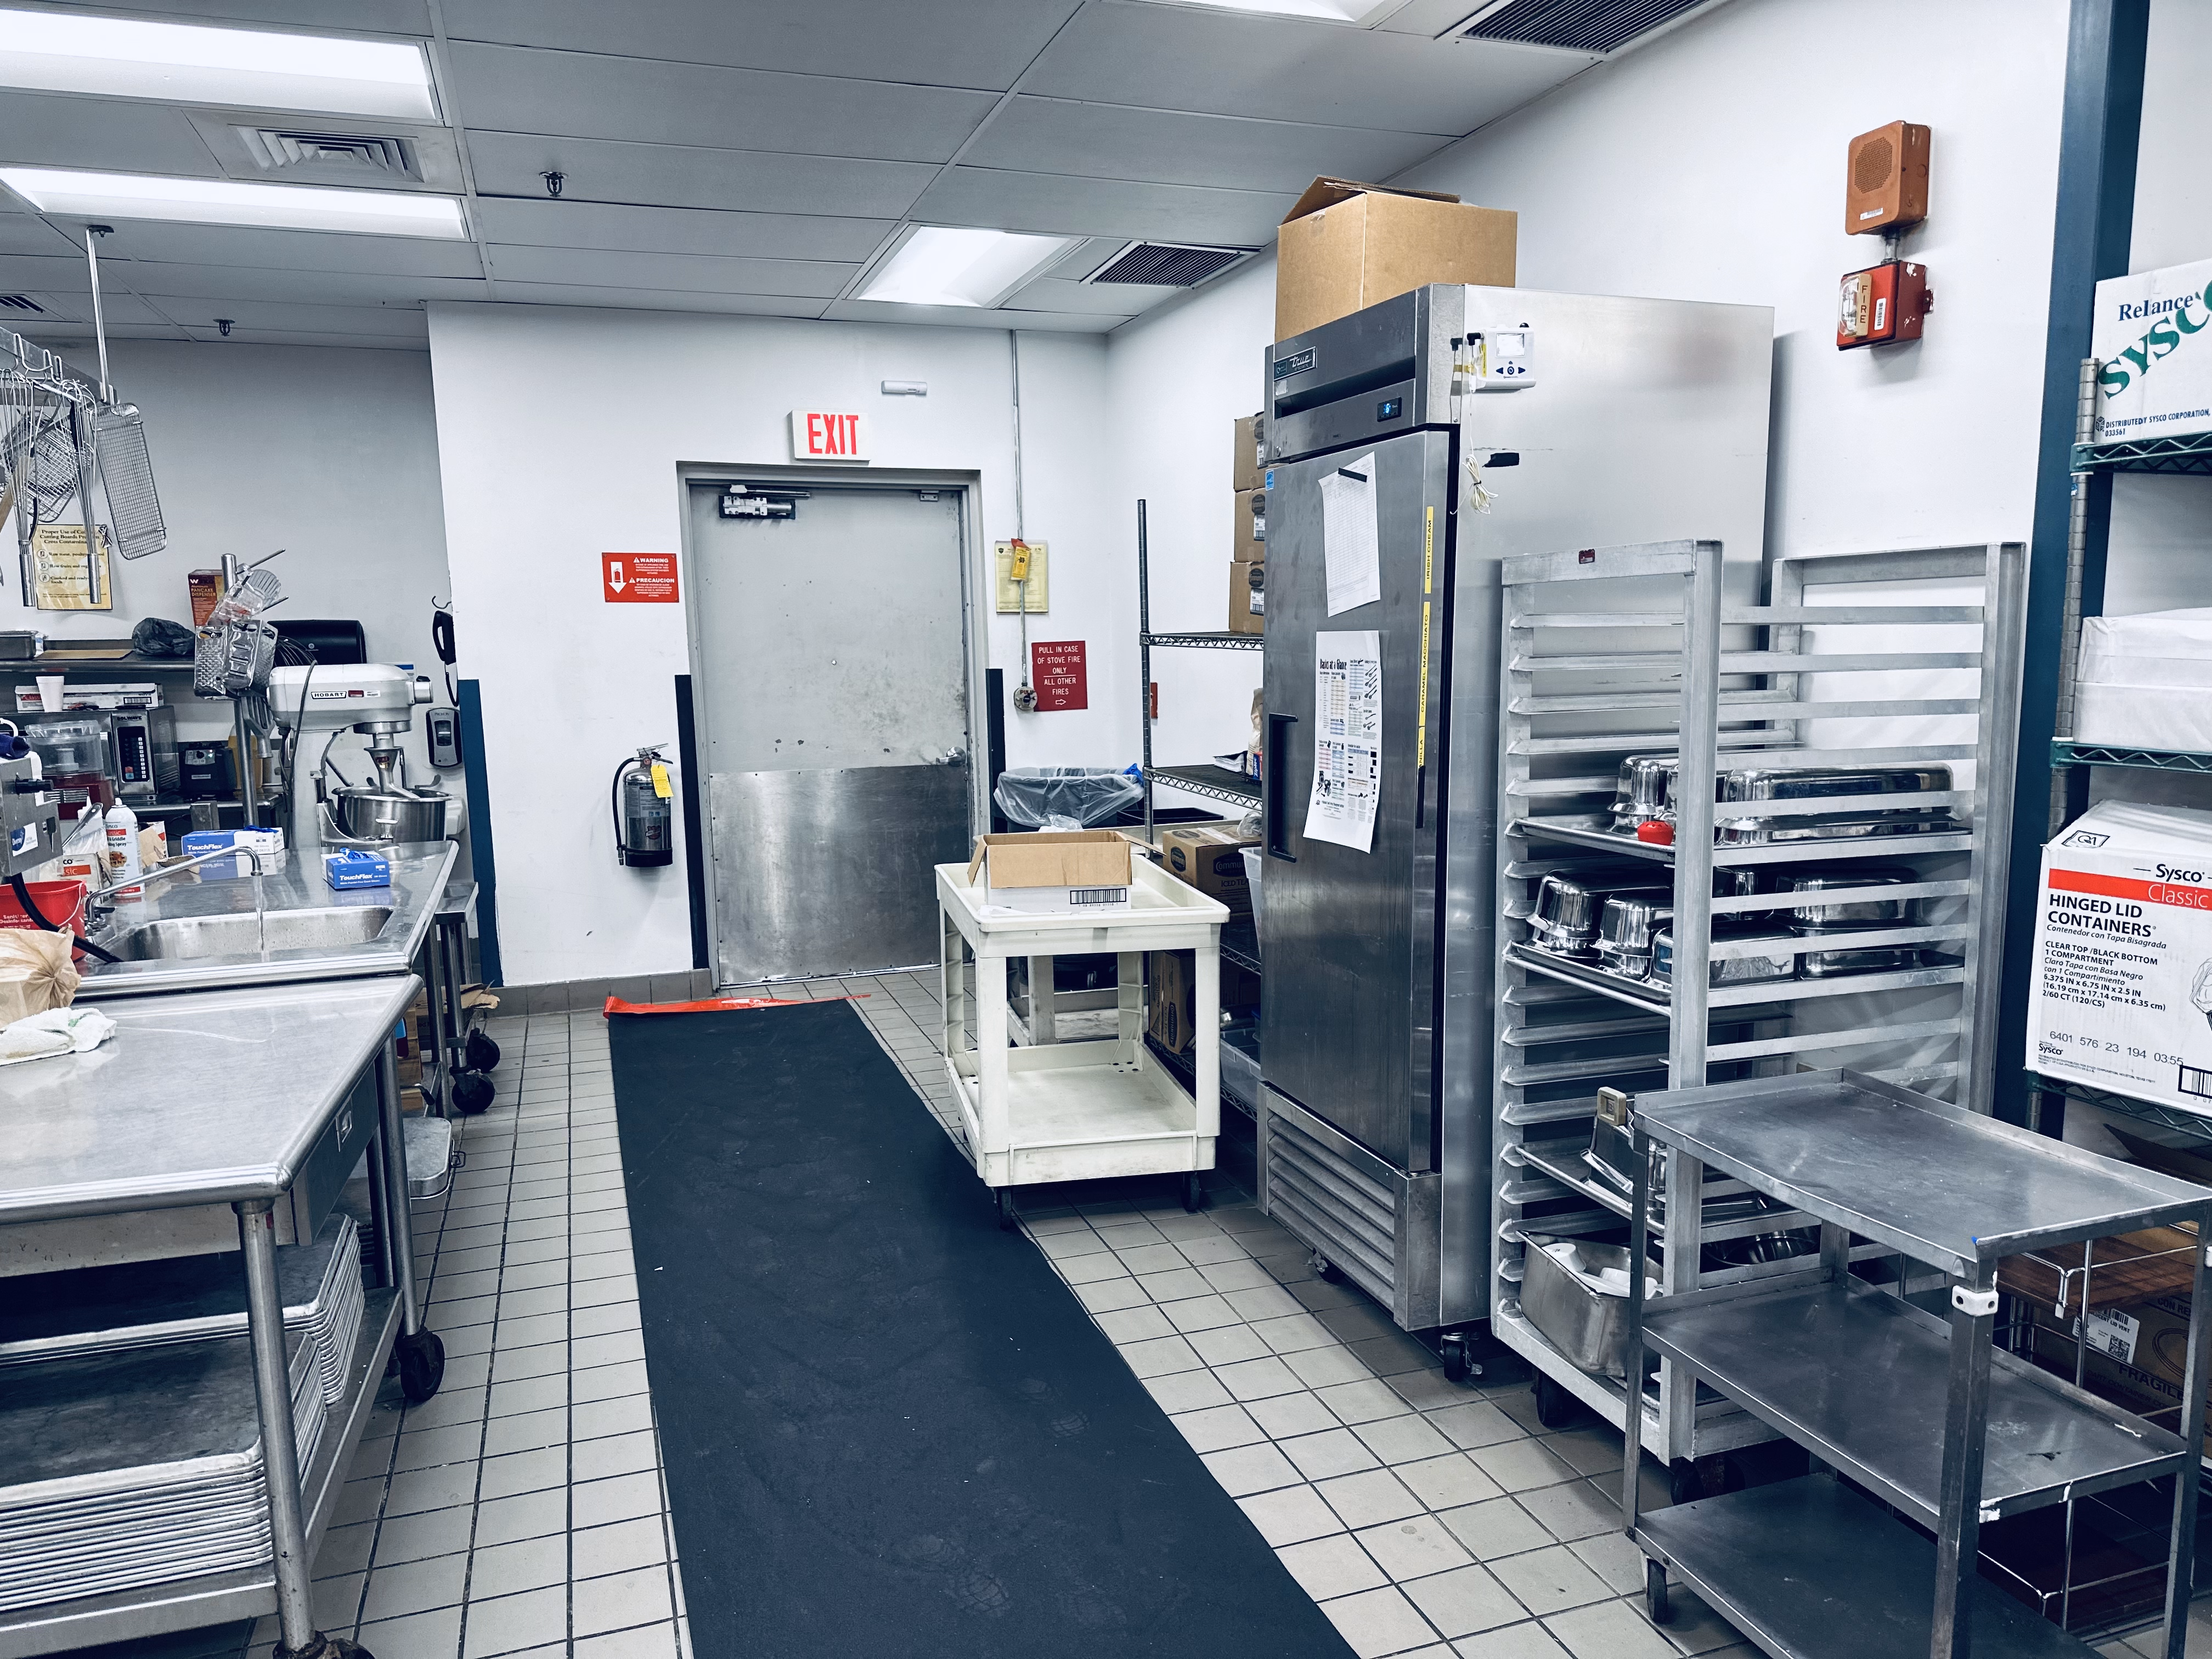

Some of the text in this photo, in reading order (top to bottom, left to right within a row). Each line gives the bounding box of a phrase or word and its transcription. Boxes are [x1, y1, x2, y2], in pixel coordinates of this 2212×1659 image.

[1860, 285, 1868, 324] FIRE
[2098, 279, 2212, 400] SYSC
[1290, 354, 1312, 368] true
[2149, 414, 2166, 423] SYSCO
[807, 413, 859, 455] EXIT
[1221, 879, 1235, 887] ICED
[2155, 863, 2204, 882] Sysco
[2049, 894, 2142, 918] HINGED LID
[2148, 883, 2209, 909] Classic
[2046, 924, 2167, 950] Contenedor con Tapa Bisagrada
[2045, 940, 2158, 966] CLEAR TOP /BLACK BOTTOM
[2051, 950, 2114, 966] COMPARTMENT
[2045, 957, 2064, 966] Claro
[2066, 960, 2084, 970] Tapa
[2100, 967, 2119, 976] Basa
[2120, 970, 2143, 981] Negro
[2064, 969, 2125, 986] Compartimiento
[2043, 981, 2067, 992] (16.19
[2088, 990, 2110, 1000] 17.14
[2131, 998, 2149, 1008] 6.35
[2150, 1003, 2166, 1012] cm)
[2044, 973, 2064, 983] 6.375
[2082, 980, 2100, 989] 6.75
[2101, 984, 2110, 992] IN
[2118, 987, 2130, 995] 2.5
[2132, 989, 2142, 997] IN
[2042, 990, 2106, 1008] 2/60 CT (120/CS)
[2039, 1043, 2063, 1055] Sysco
[2050, 1031, 2184, 1066] 6401 576 23 194 03:55
[2157, 1297, 2176, 1311] CON
[2118, 1324, 2131, 1334] VENT
